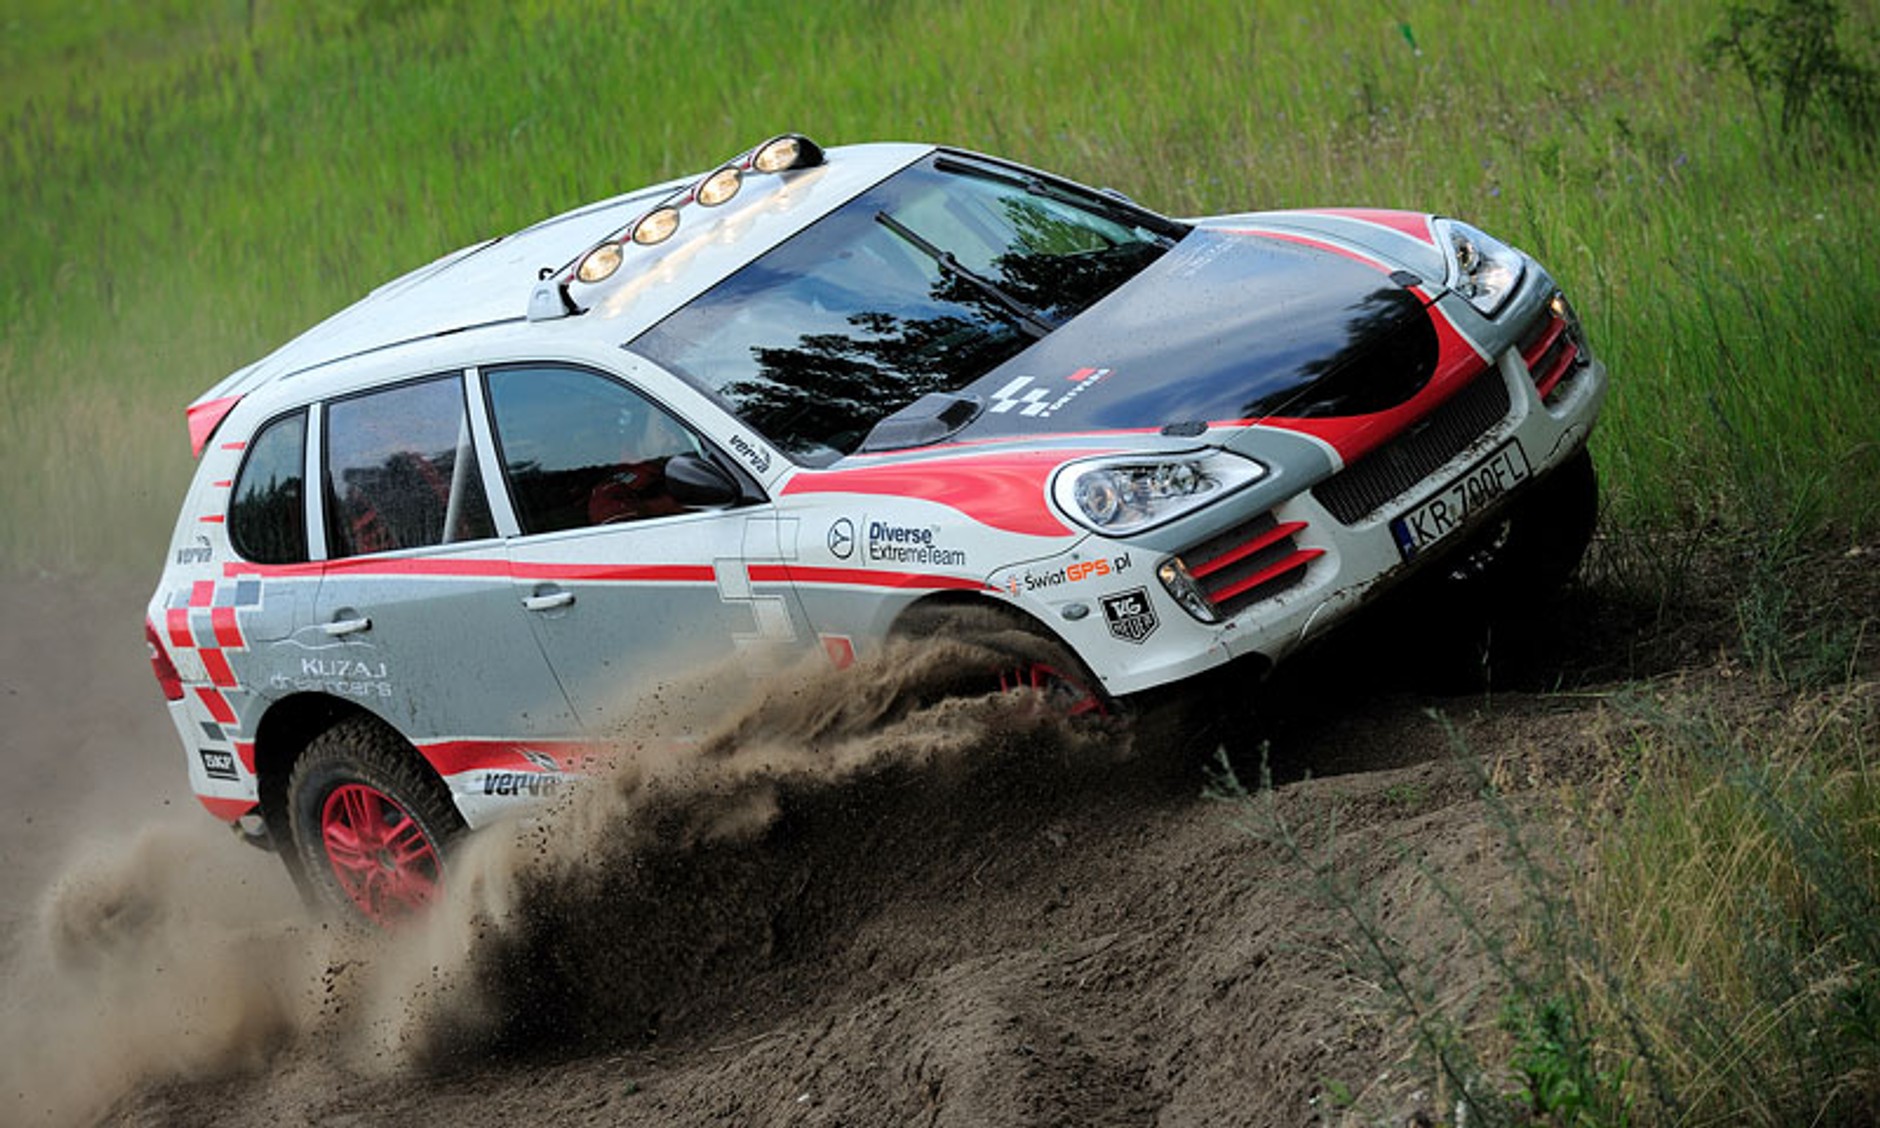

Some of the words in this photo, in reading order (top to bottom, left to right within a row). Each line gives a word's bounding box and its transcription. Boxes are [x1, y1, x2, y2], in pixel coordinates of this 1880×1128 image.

[729, 434, 770, 474] verva
[869, 521, 932, 544] Diverse
[1411, 500, 1453, 547] KR
[869, 541, 966, 566] ExtremeTeam
[204, 753, 232, 770] SKF
